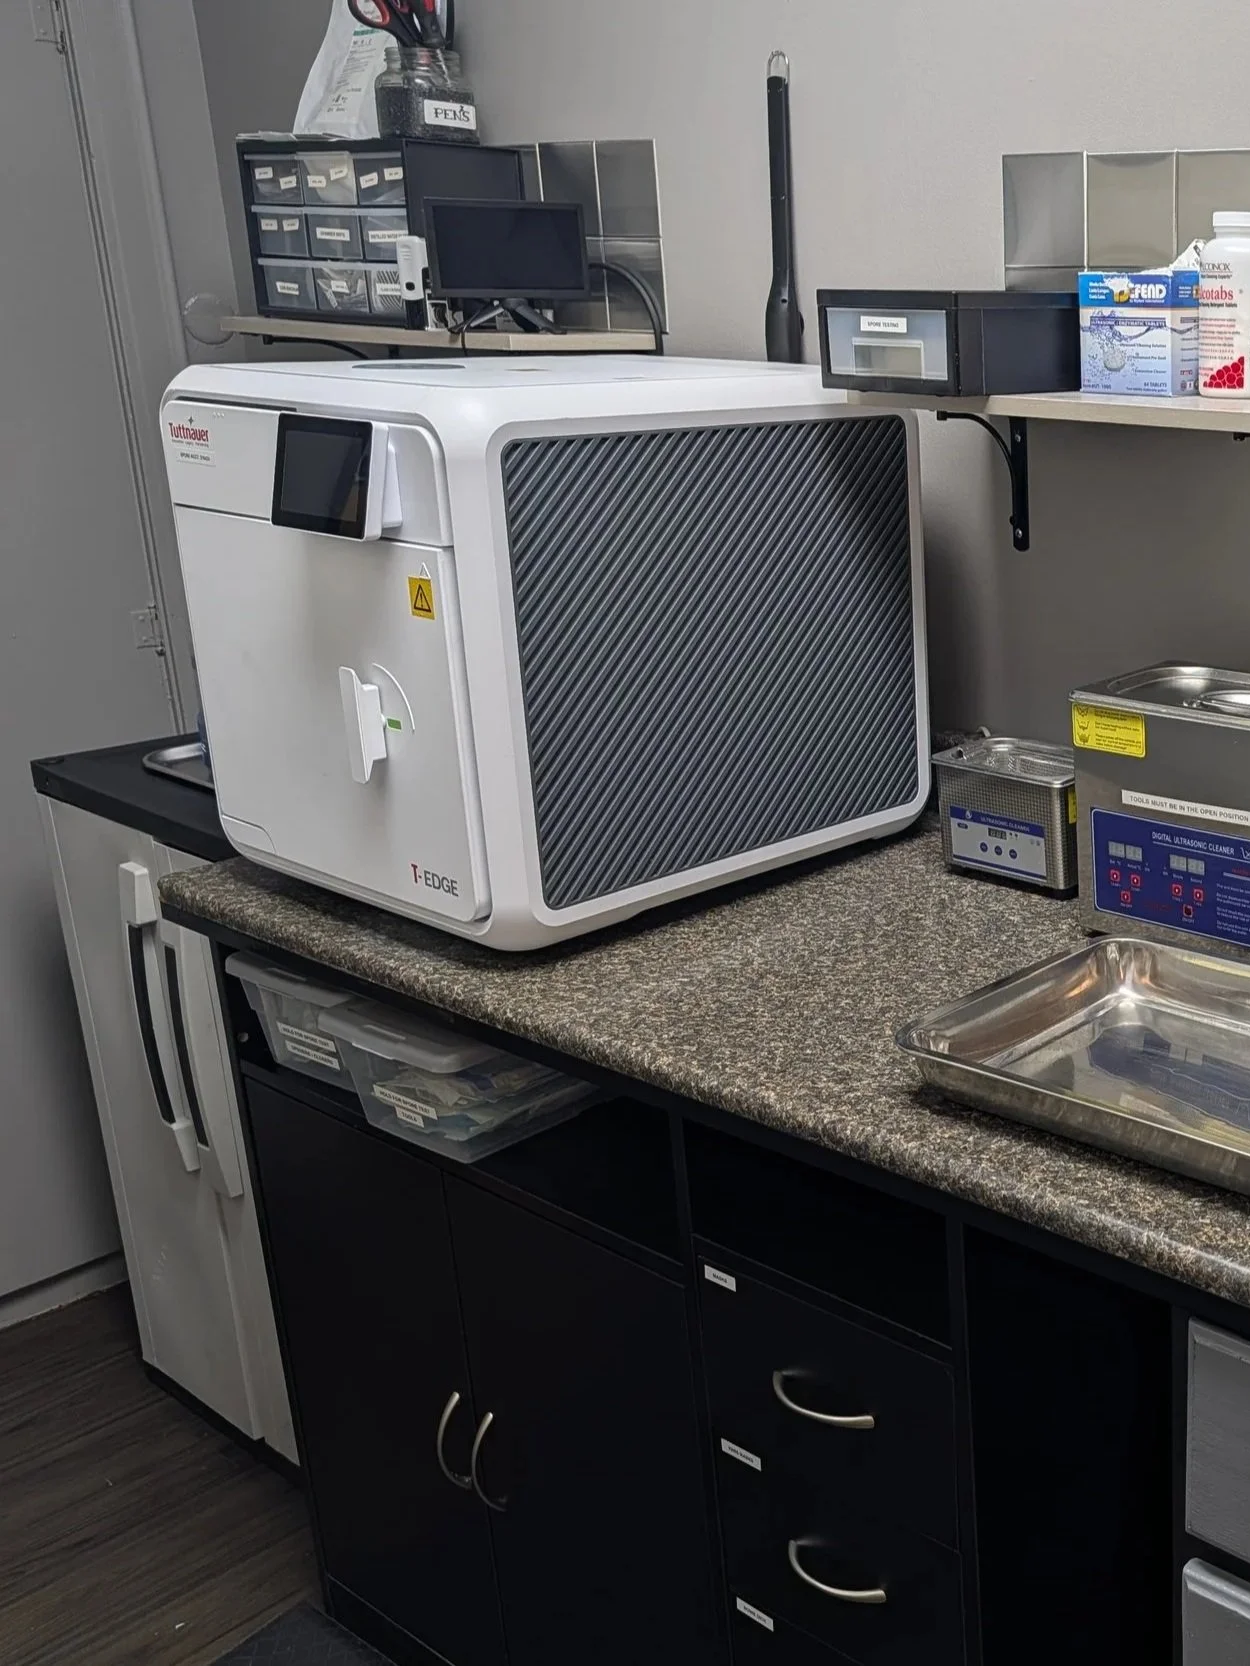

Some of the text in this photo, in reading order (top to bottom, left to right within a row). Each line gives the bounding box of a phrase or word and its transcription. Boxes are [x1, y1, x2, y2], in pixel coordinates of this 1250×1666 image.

[168, 422, 209, 442] Tuttnauer
[1130, 795, 1150, 805] TOOLS
[1151, 799, 1168, 808] MUST
[1200, 808, 1218, 816] OPEN
[1219, 811, 1249, 822] POSITION
[1152, 831, 1235, 855] DIGITAL ULTRASONIC CLEANER
